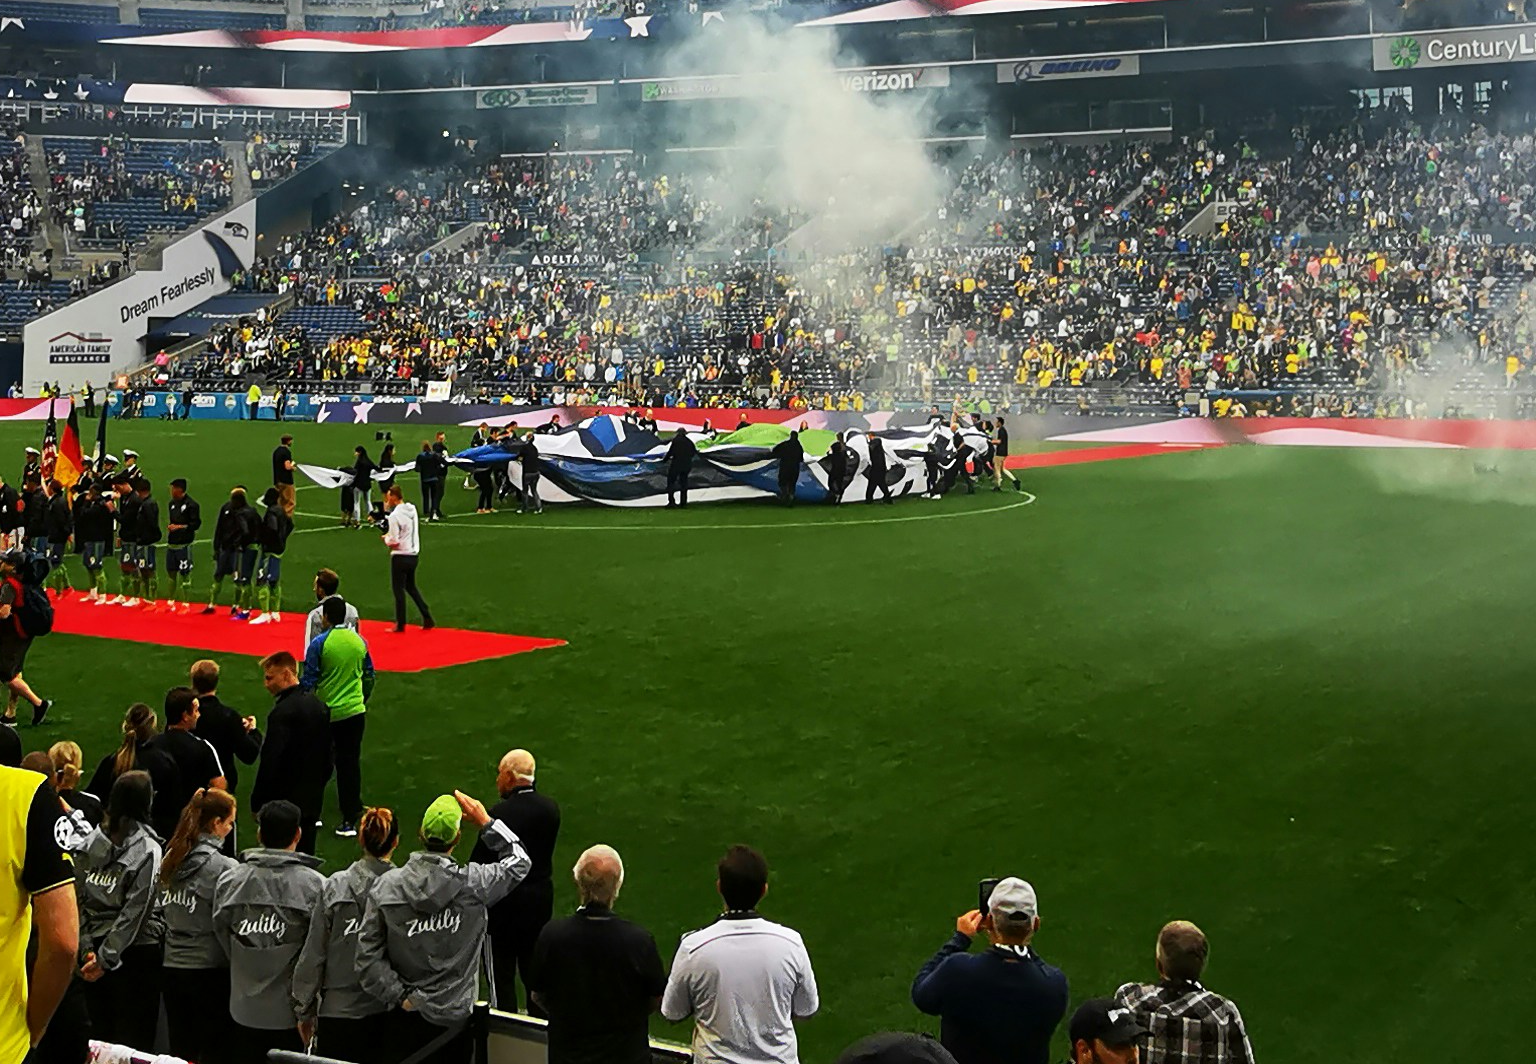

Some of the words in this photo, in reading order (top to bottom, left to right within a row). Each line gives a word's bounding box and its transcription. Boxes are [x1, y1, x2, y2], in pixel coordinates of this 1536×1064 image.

[841, 70, 915, 92] verizon
[542, 254, 580, 265] DELTA
[120, 294, 159, 324] Dream
[160, 265, 216, 304] Fearlessly
[49, 344, 86, 354] AMERICAN
[87, 344, 111, 354] FAMILY
